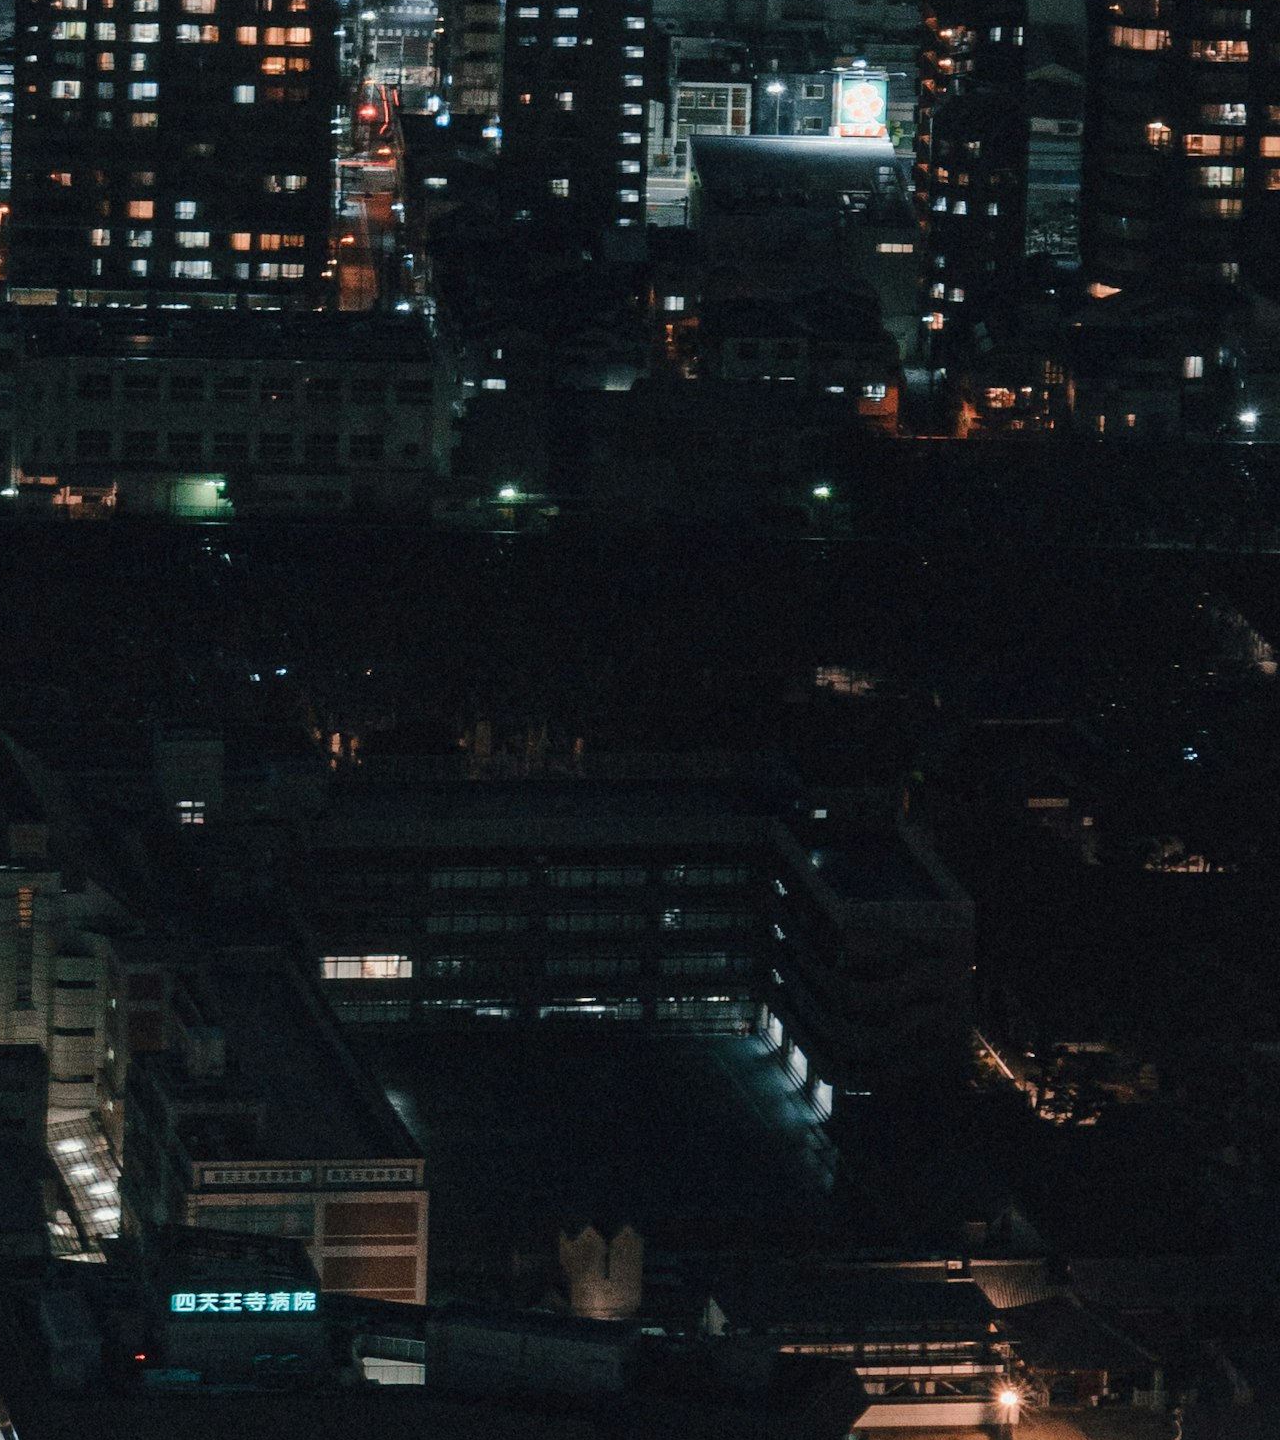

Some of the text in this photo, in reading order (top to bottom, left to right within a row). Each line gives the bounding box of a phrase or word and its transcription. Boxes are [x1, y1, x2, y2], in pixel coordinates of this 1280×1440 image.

[175, 1292, 317, 1312] 四天王寺病院
